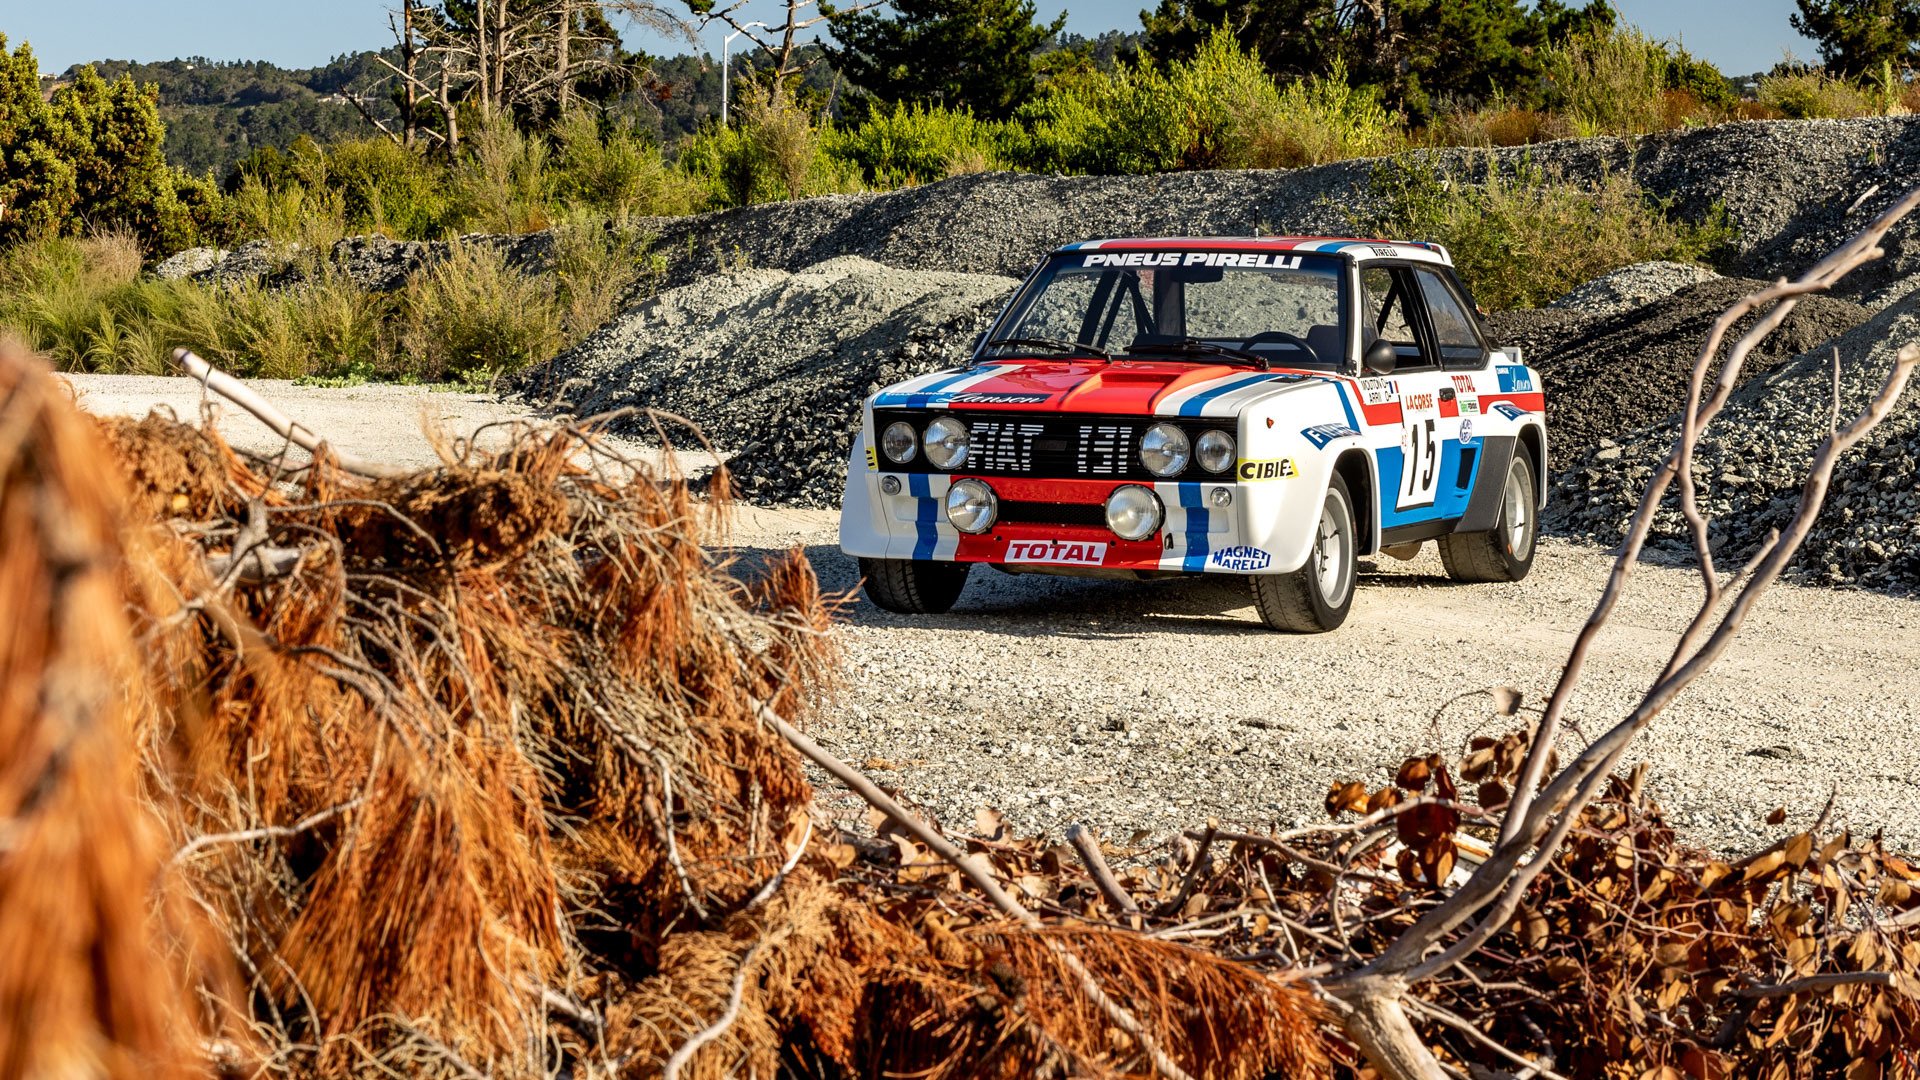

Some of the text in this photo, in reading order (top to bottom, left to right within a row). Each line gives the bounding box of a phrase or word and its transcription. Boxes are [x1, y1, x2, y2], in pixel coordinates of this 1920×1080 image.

[1082, 253, 1302, 269] PNEUS PIRELLI
[1451, 374, 1476, 393] TOTAL
[968, 422, 1133, 474] FIAT 131
[1408, 419, 1436, 496] 15
[1012, 543, 1101, 562] TOTAL
[1212, 546, 1271, 565] MAGNETI
[1212, 553, 1271, 571] MARELLI
